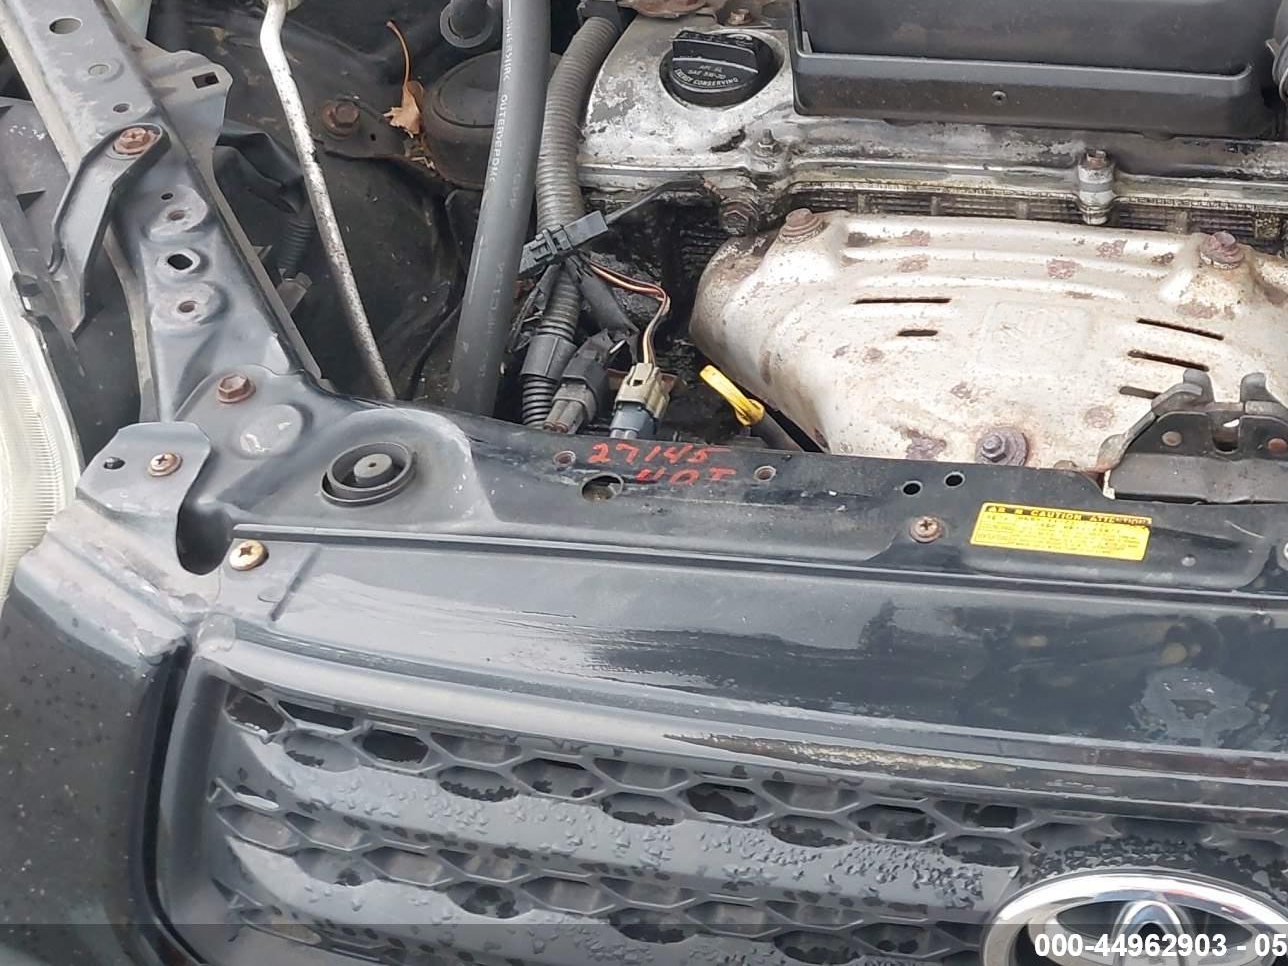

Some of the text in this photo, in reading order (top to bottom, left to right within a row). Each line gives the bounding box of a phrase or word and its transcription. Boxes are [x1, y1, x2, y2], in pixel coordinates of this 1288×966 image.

[674, 68, 739, 87] ENERGY CONSERVING
[1030, 509, 1082, 521] CAUTION
